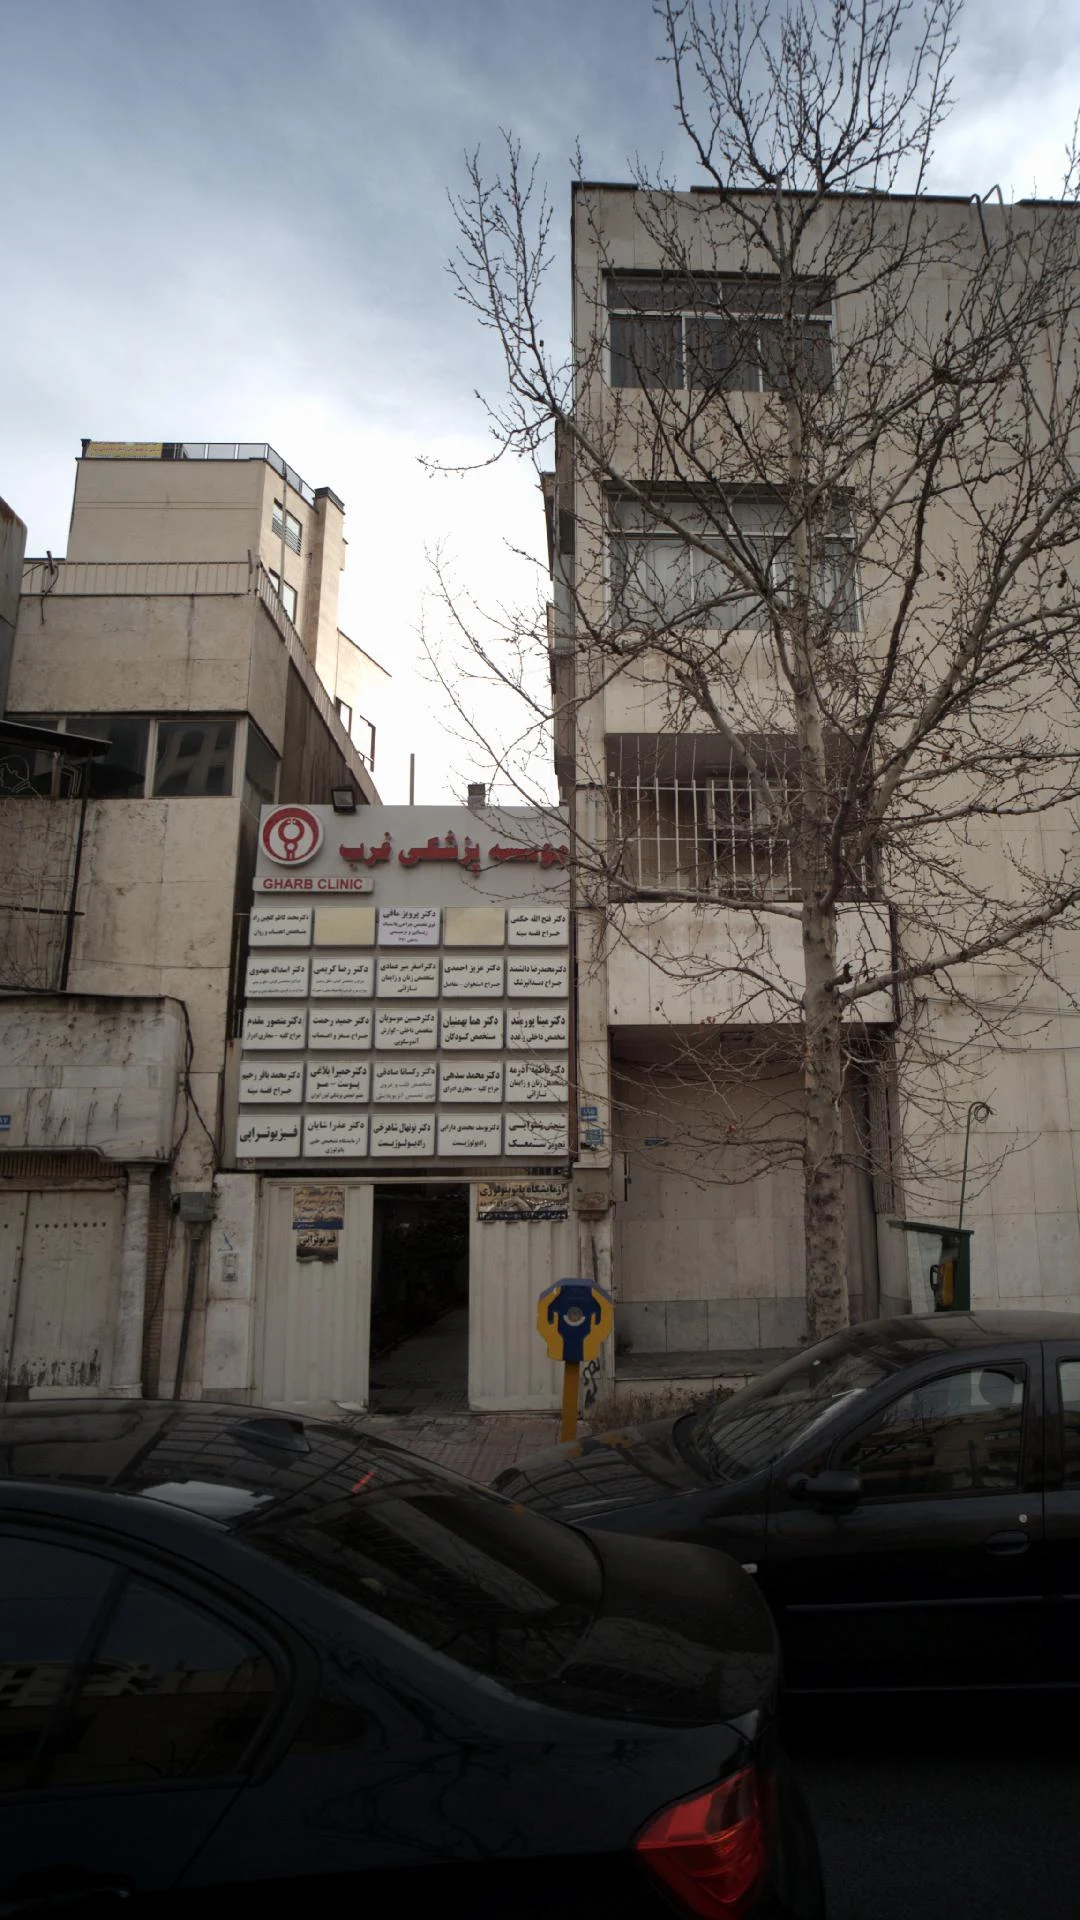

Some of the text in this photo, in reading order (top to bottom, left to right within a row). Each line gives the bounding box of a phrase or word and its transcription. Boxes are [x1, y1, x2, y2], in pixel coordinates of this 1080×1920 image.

[339, 832, 391, 870] غرب
[398, 830, 480, 879] پزشکی
[263, 879, 362, 889] GHARB CLINIC
[299, 914, 309, 922] دکتر
[400, 911, 420, 919] پرویز
[420, 910, 436, 919] دکتر
[531, 914, 540, 922] الله
[541, 915, 551, 924] فتح
[553, 915, 566, 924] دکتر
[541, 930, 560, 938] جراح
[291, 966, 305, 975] دکتر
[313, 964, 368, 975] دکتر رضا کریمی
[424, 963, 436, 971] دکتر
[444, 964, 500, 973] دکتر عزیز احمدی
[555, 965, 567, 975] دکتر
[249, 968, 270, 976] مهدوی
[402, 974, 413, 982] زنان
[545, 979, 562, 988] جراح
[247, 1016, 302, 1028] دکتر منصور مقدم
[312, 1016, 369, 1027] دکتر حمید رحمت
[421, 1014, 435, 1023] دکتر
[469, 1016, 481, 1025] هما
[483, 1016, 498, 1028] دکتر
[537, 1015, 549, 1027] مینا
[548, 1015, 565, 1028] دکتر
[351, 1032, 368, 1040] جراح
[445, 1033, 496, 1042] متخصص کودکان
[526, 1033, 543, 1042] داخلی
[545, 1034, 566, 1043] متخصص
[331, 1066, 351, 1078] حمیرا
[351, 1066, 367, 1078] دکتر
[421, 1067, 436, 1078] دکتر
[549, 1064, 565, 1077] دکتر
[258, 1070, 270, 1081] باقر
[287, 1071, 300, 1081] دکتر
[484, 1071, 500, 1081] دکتر
[337, 1080, 360, 1090] پوست
[273, 1087, 292, 1096] جراح
[307, 1121, 365, 1131] دکتر عذرا شایان
[417, 1123, 431, 1134] دکتر
[489, 1124, 500, 1133] دکتر
[240, 1125, 298, 1143] فیزیوتراپی
[377, 1138, 426, 1149] رادیولوژیست
[508, 1138, 546, 1147] سمعک
